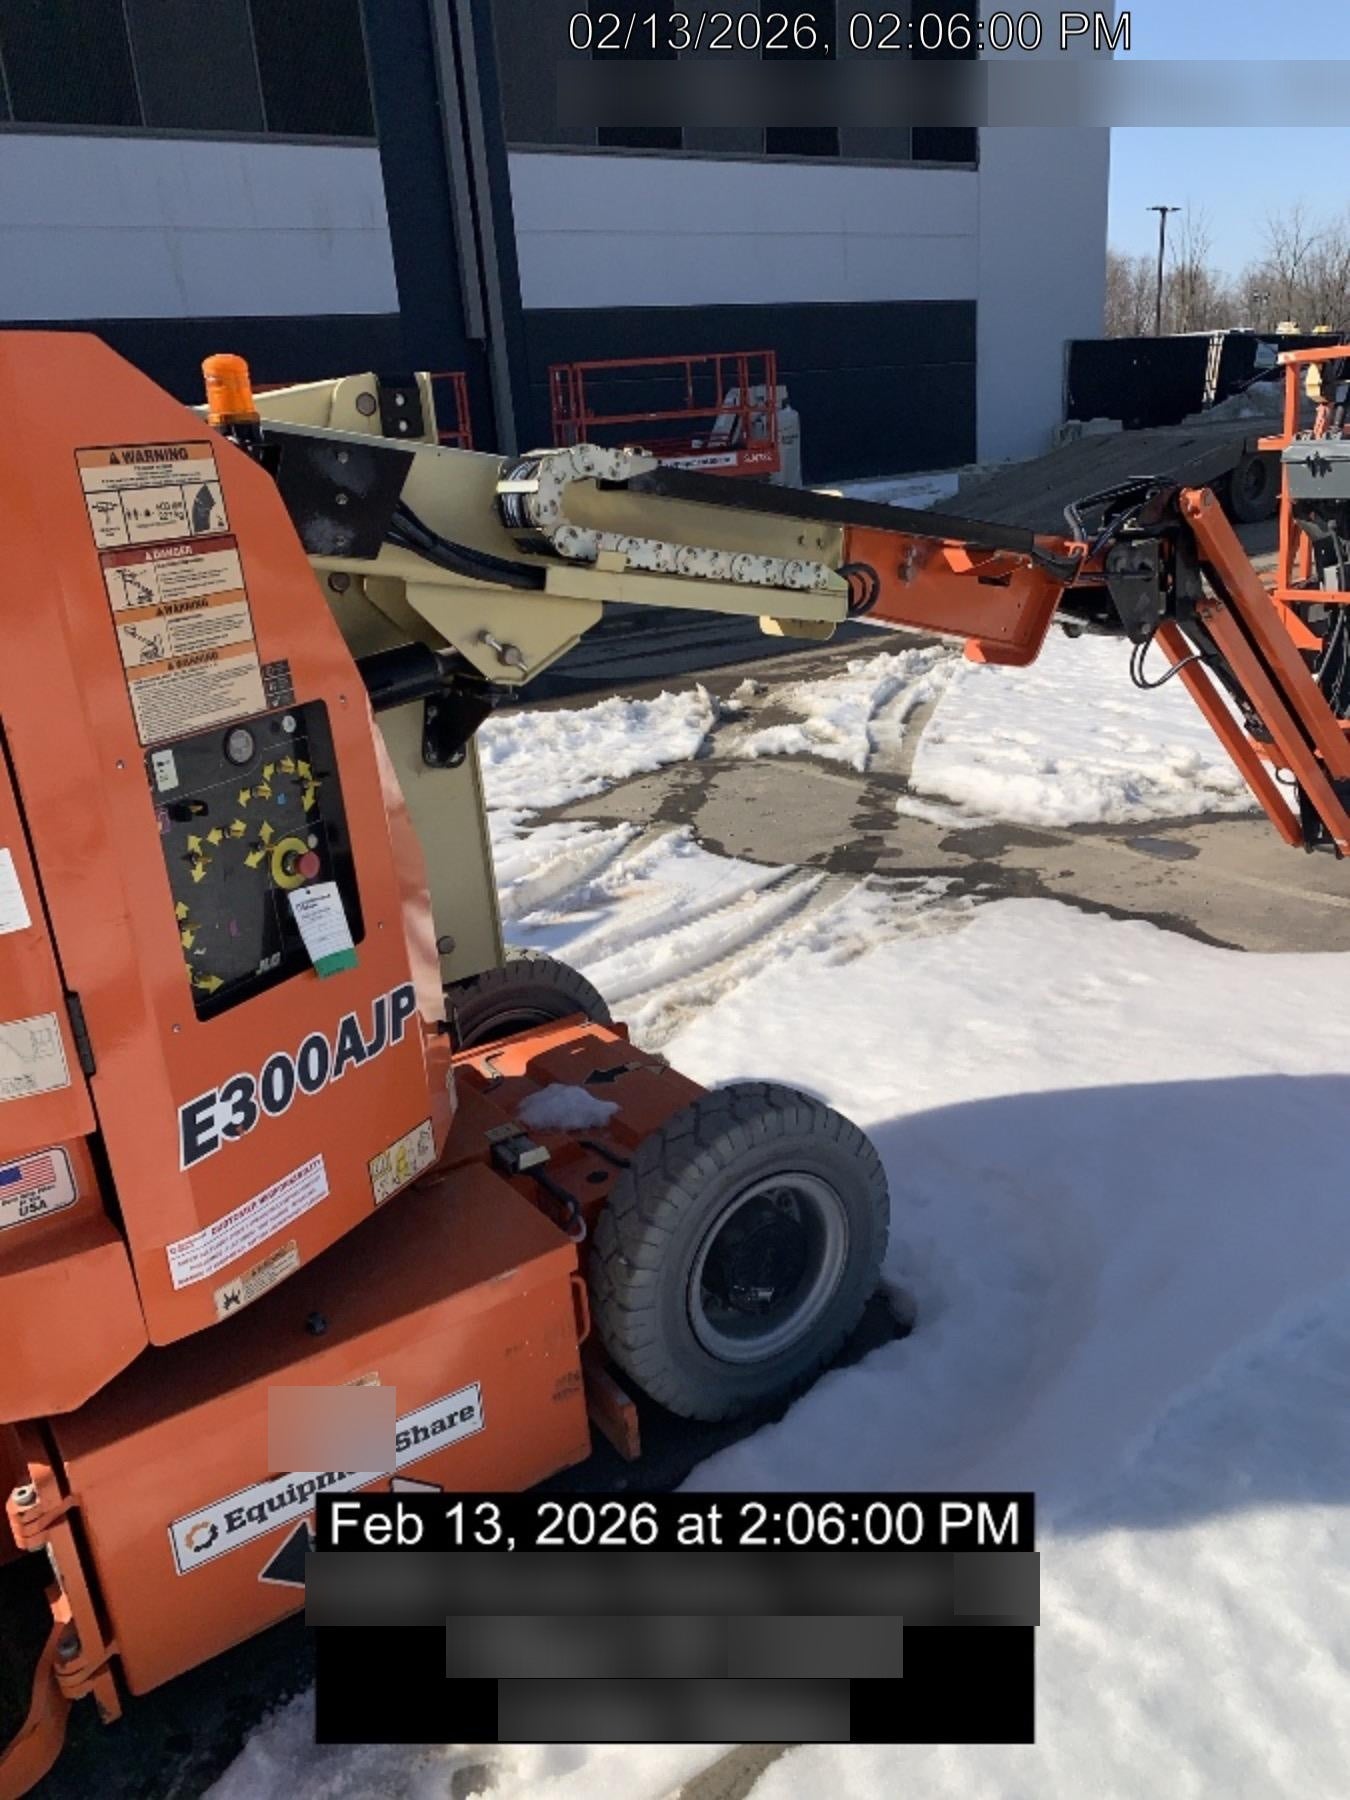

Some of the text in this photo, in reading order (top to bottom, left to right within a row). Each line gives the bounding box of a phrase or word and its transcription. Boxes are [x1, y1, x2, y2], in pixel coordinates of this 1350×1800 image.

[122, 447, 188, 463] WARNING
[255, 951, 281, 975] JLG
[178, 982, 416, 1171] E300AJP
[19, 1199, 48, 1217] USA
